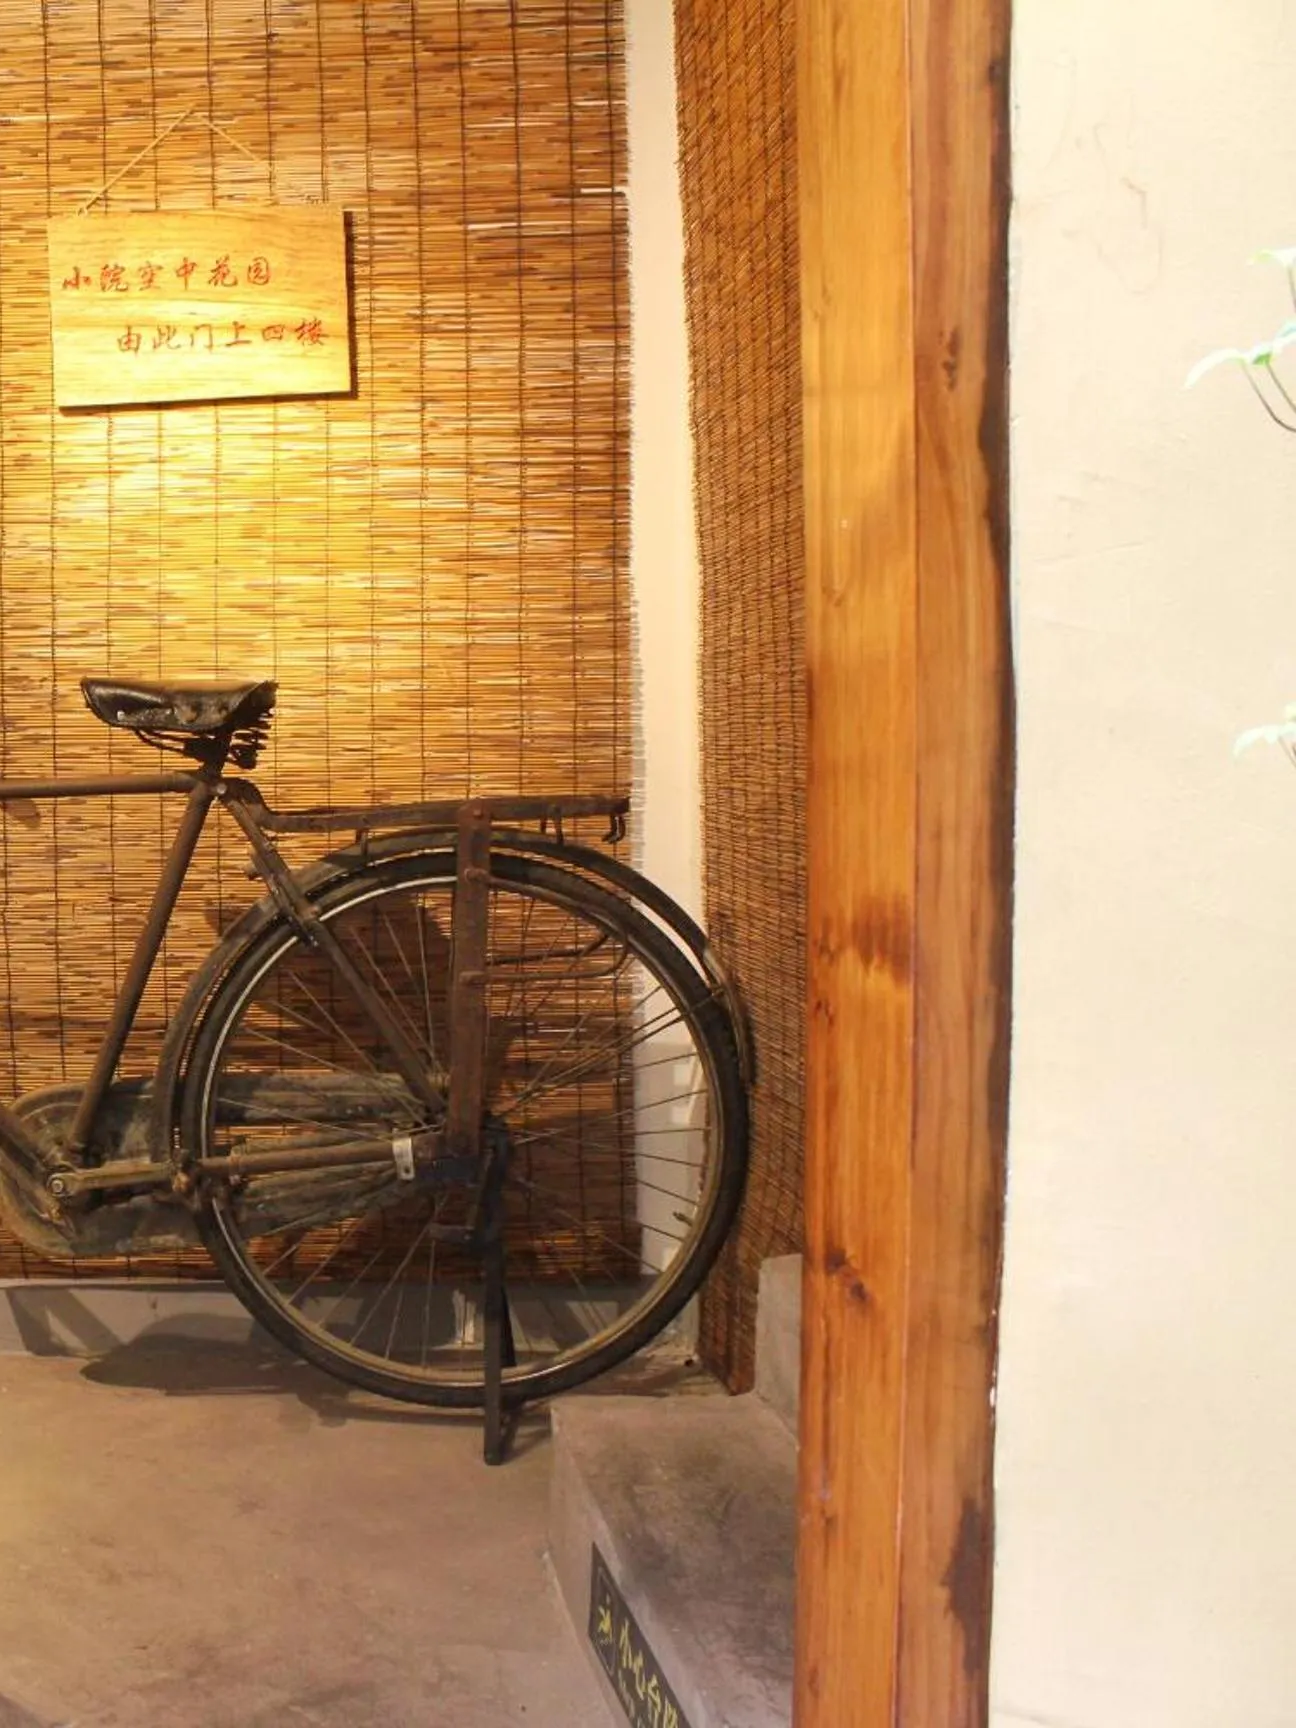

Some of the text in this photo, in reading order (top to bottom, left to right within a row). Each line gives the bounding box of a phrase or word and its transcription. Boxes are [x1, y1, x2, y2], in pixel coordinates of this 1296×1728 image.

[62, 255, 272, 292] 小院空中花园
[117, 318, 329, 356] 由此门上四楼
